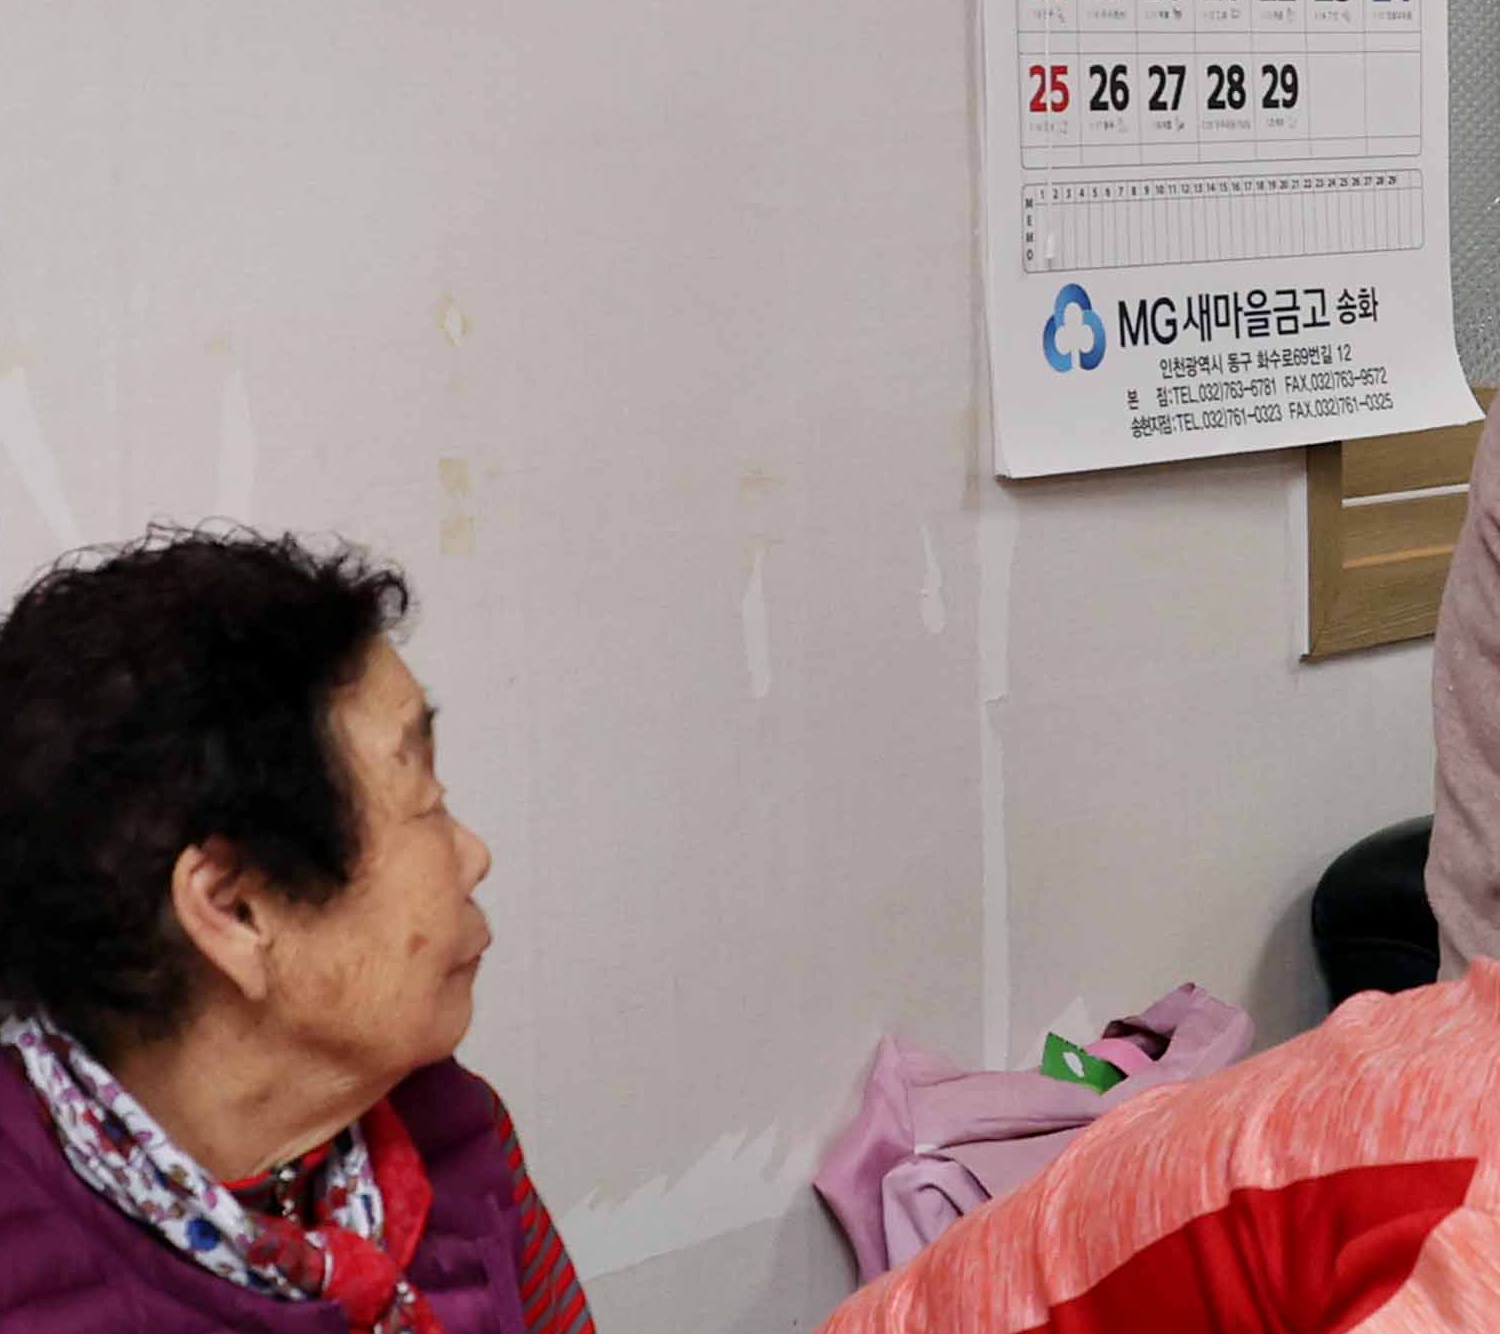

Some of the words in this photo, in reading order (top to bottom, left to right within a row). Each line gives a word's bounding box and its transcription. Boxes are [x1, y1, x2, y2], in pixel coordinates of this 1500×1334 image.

[1030, 65, 1069, 112] 25
[1090, 65, 1129, 111] 26
[1148, 65, 1186, 111] 27
[1207, 65, 1246, 110] 28
[1262, 64, 1298, 109] 29
[1040, 190, 1044, 199] 1
[1053, 189, 1058, 199] 2
[1066, 188, 1072, 198] 3
[1079, 188, 1085, 197] 4
[1092, 188, 1097, 197] 5
[1105, 188, 1110, 197] 6
[1118, 187, 1124, 196] 7
[1131, 186, 1136, 196] 8
[1144, 185, 1149, 195] 9
[1156, 185, 1164, 194] 10
[1168, 185, 1177, 193] 11
[1181, 184, 1189, 193] 12
[1194, 183, 1202, 193] 13
[1207, 183, 1215, 192] 14
[1220, 183, 1227, 192] 15
[1232, 182, 1240, 191] 16
[1244, 182, 1252, 191] 17
[1256, 181, 1264, 190] 18
[1268, 181, 1276, 189] 19
[1280, 180, 1288, 189] 20
[1292, 180, 1299, 188] 21
[1304, 179, 1312, 188] 22
[1316, 178, 1324, 187] 23
[1328, 178, 1336, 187] 24
[1340, 178, 1348, 187] 25
[1352, 177, 1360, 186] 26
[1364, 176, 1372, 185] 27
[1376, 176, 1384, 185] 28
[1388, 176, 1396, 184] 29
[1118, 297, 1177, 348] MG
[1182, 289, 1331, 342] 새마을금고
[1336, 287, 1379, 325] 송화
[1160, 353, 1224, 379] 인천광역시
[1228, 351, 1252, 373] 동구
[1257, 345, 1332, 369] 화수로69번길
[1338, 344, 1352, 361] 12
